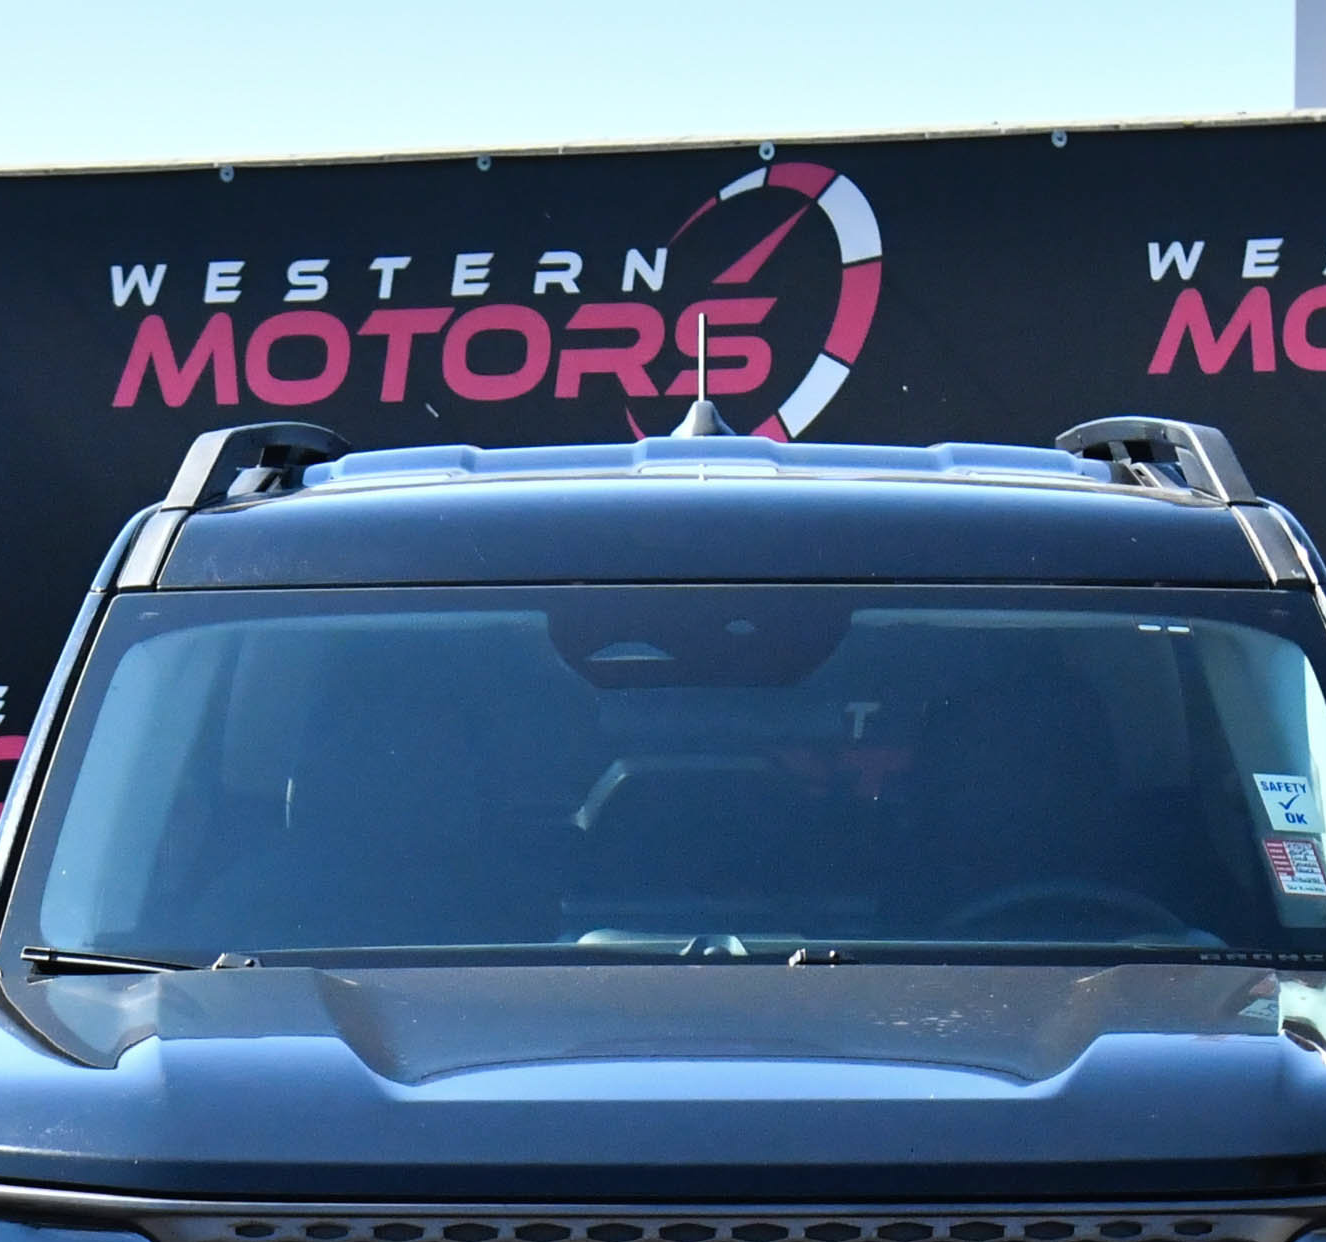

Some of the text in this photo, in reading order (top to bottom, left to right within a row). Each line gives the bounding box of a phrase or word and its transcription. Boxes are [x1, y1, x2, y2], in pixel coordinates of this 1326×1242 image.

[110, 246, 668, 308] WESTERN
[112, 296, 777, 408] MOTORS
[1260, 780, 1307, 794] SAFETY
[1284, 811, 1309, 825] OK
